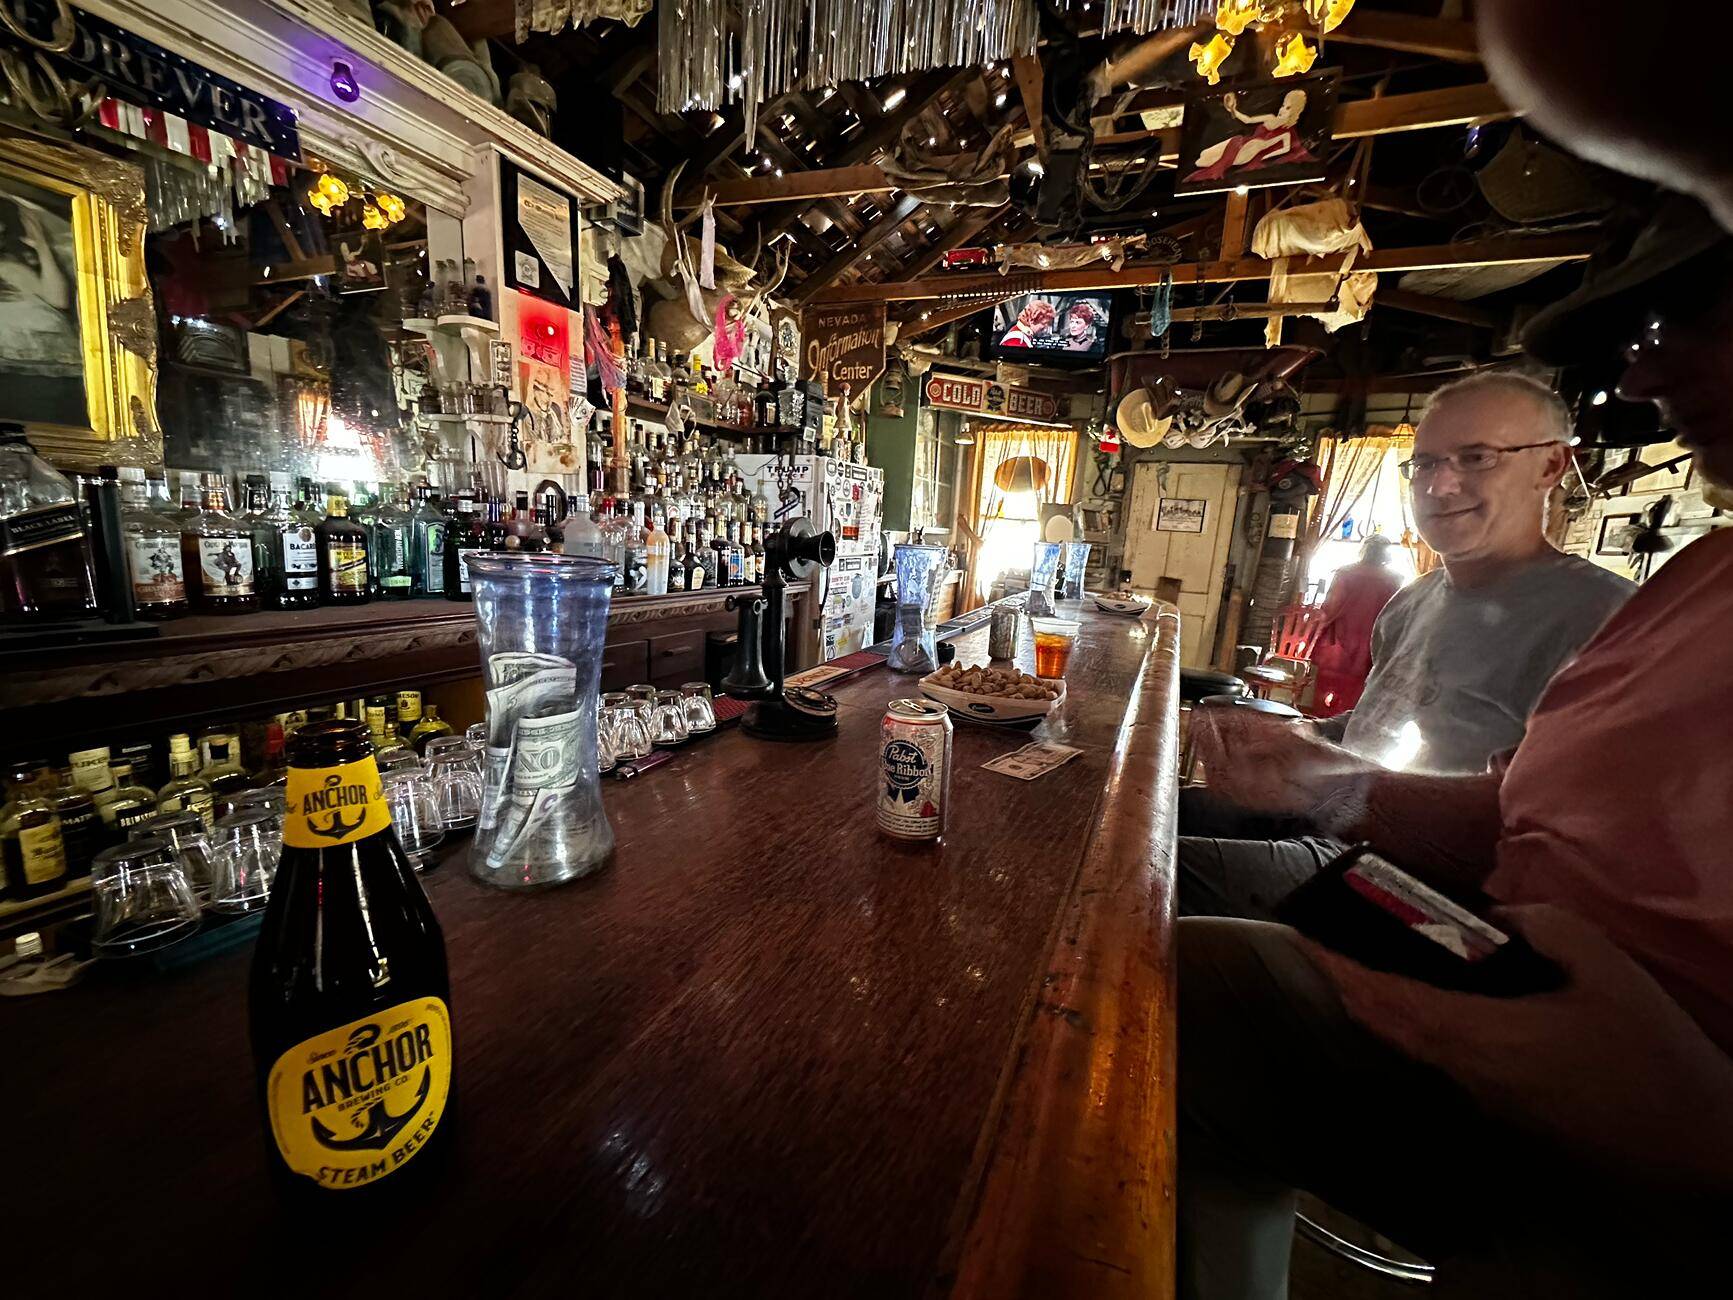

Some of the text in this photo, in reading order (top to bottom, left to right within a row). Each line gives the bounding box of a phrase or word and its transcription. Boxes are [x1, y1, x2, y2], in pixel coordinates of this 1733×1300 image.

[818, 313, 866, 329] NEVADA
[808, 327, 880, 382] Information
[832, 360, 873, 381] Center
[942, 382, 1043, 416] COLD BEER
[767, 465, 809, 474] TRUMP
[888, 746, 917, 764] Pabst
[302, 784, 368, 816] ANCHOR
[302, 1022, 434, 1115] ANCHOR
[337, 1085, 391, 1112] BREWING
[317, 1158, 386, 1184] STEAM
